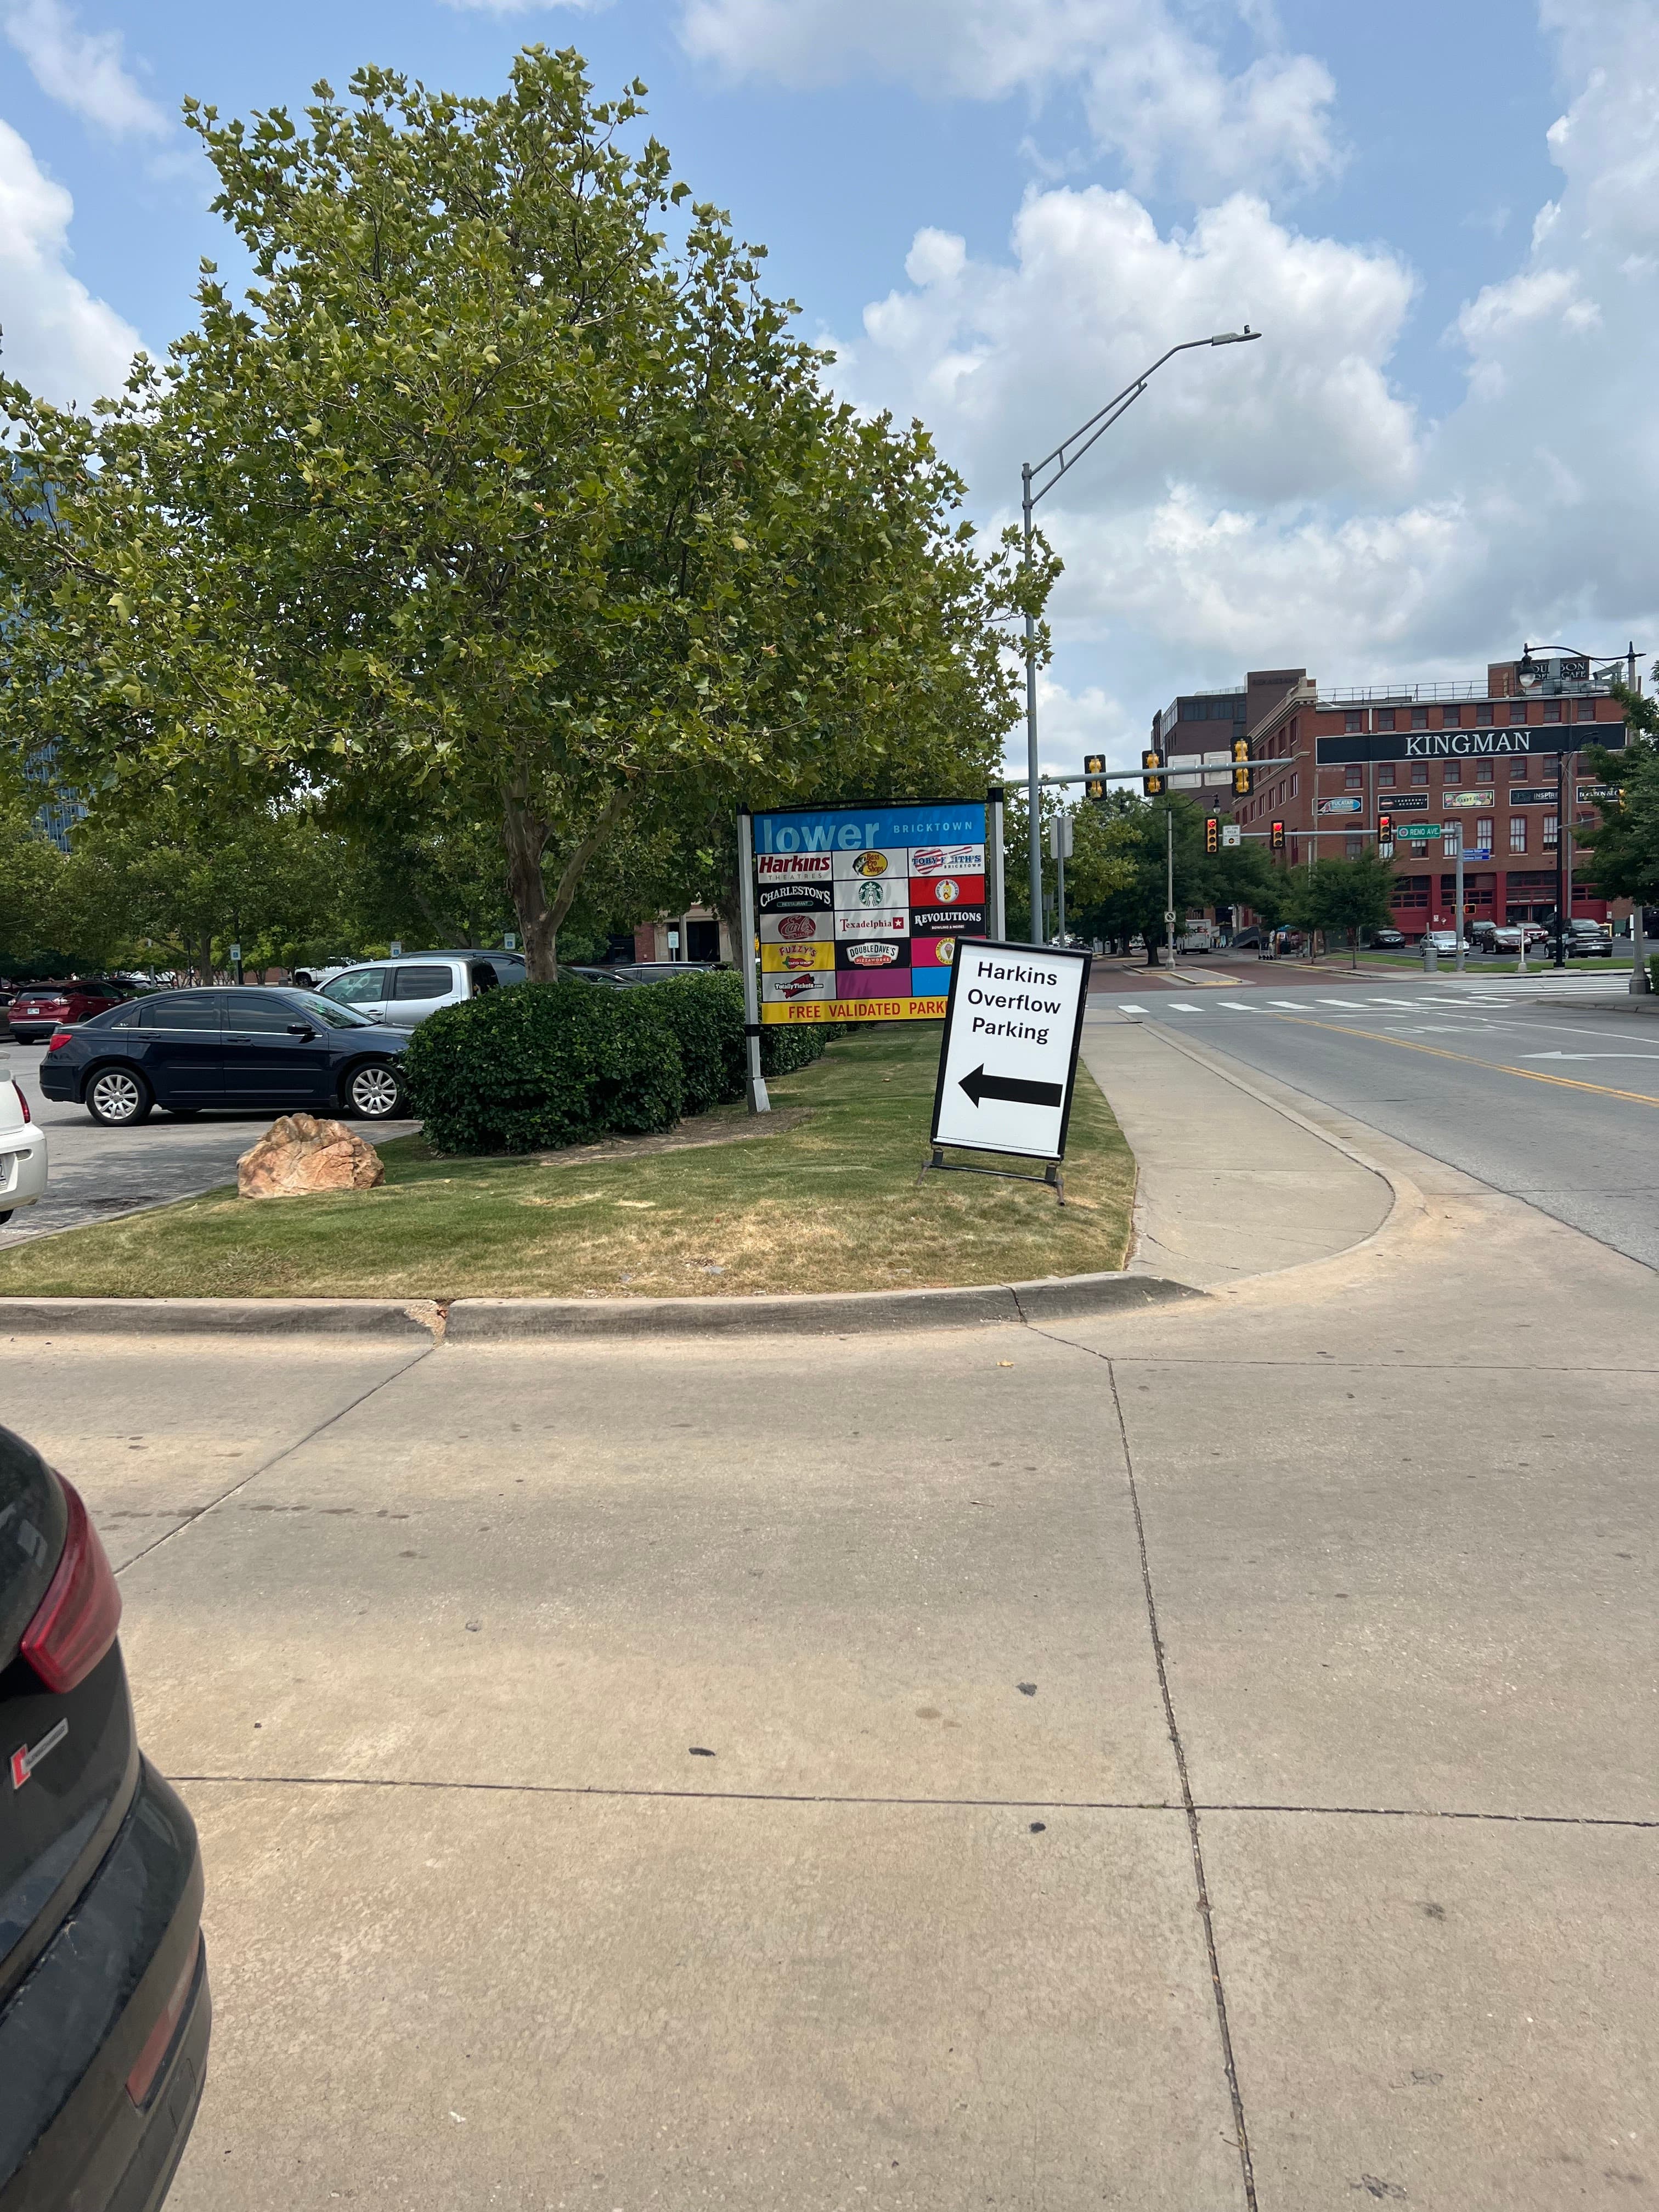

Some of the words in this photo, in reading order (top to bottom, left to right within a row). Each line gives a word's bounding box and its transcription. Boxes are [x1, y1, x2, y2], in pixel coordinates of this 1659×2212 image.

[1404, 731, 1532, 756] KINGMAN
[763, 819, 879, 853] lower
[894, 821, 972, 833] BRICKTOWN
[759, 855, 830, 873] Harkins
[760, 886, 831, 907] CHARLESTON'S
[840, 919, 892, 932] Texadelphia
[915, 912, 981, 926] REVOLUTIONS
[779, 945, 817, 957] FUZZY'S
[978, 961, 1058, 986] Harkins
[789, 1006, 821, 1019] FREE
[828, 1003, 901, 1017] VALIDATED
[968, 989, 1062, 1014] Overflow
[972, 1017, 1049, 1045] Parking
